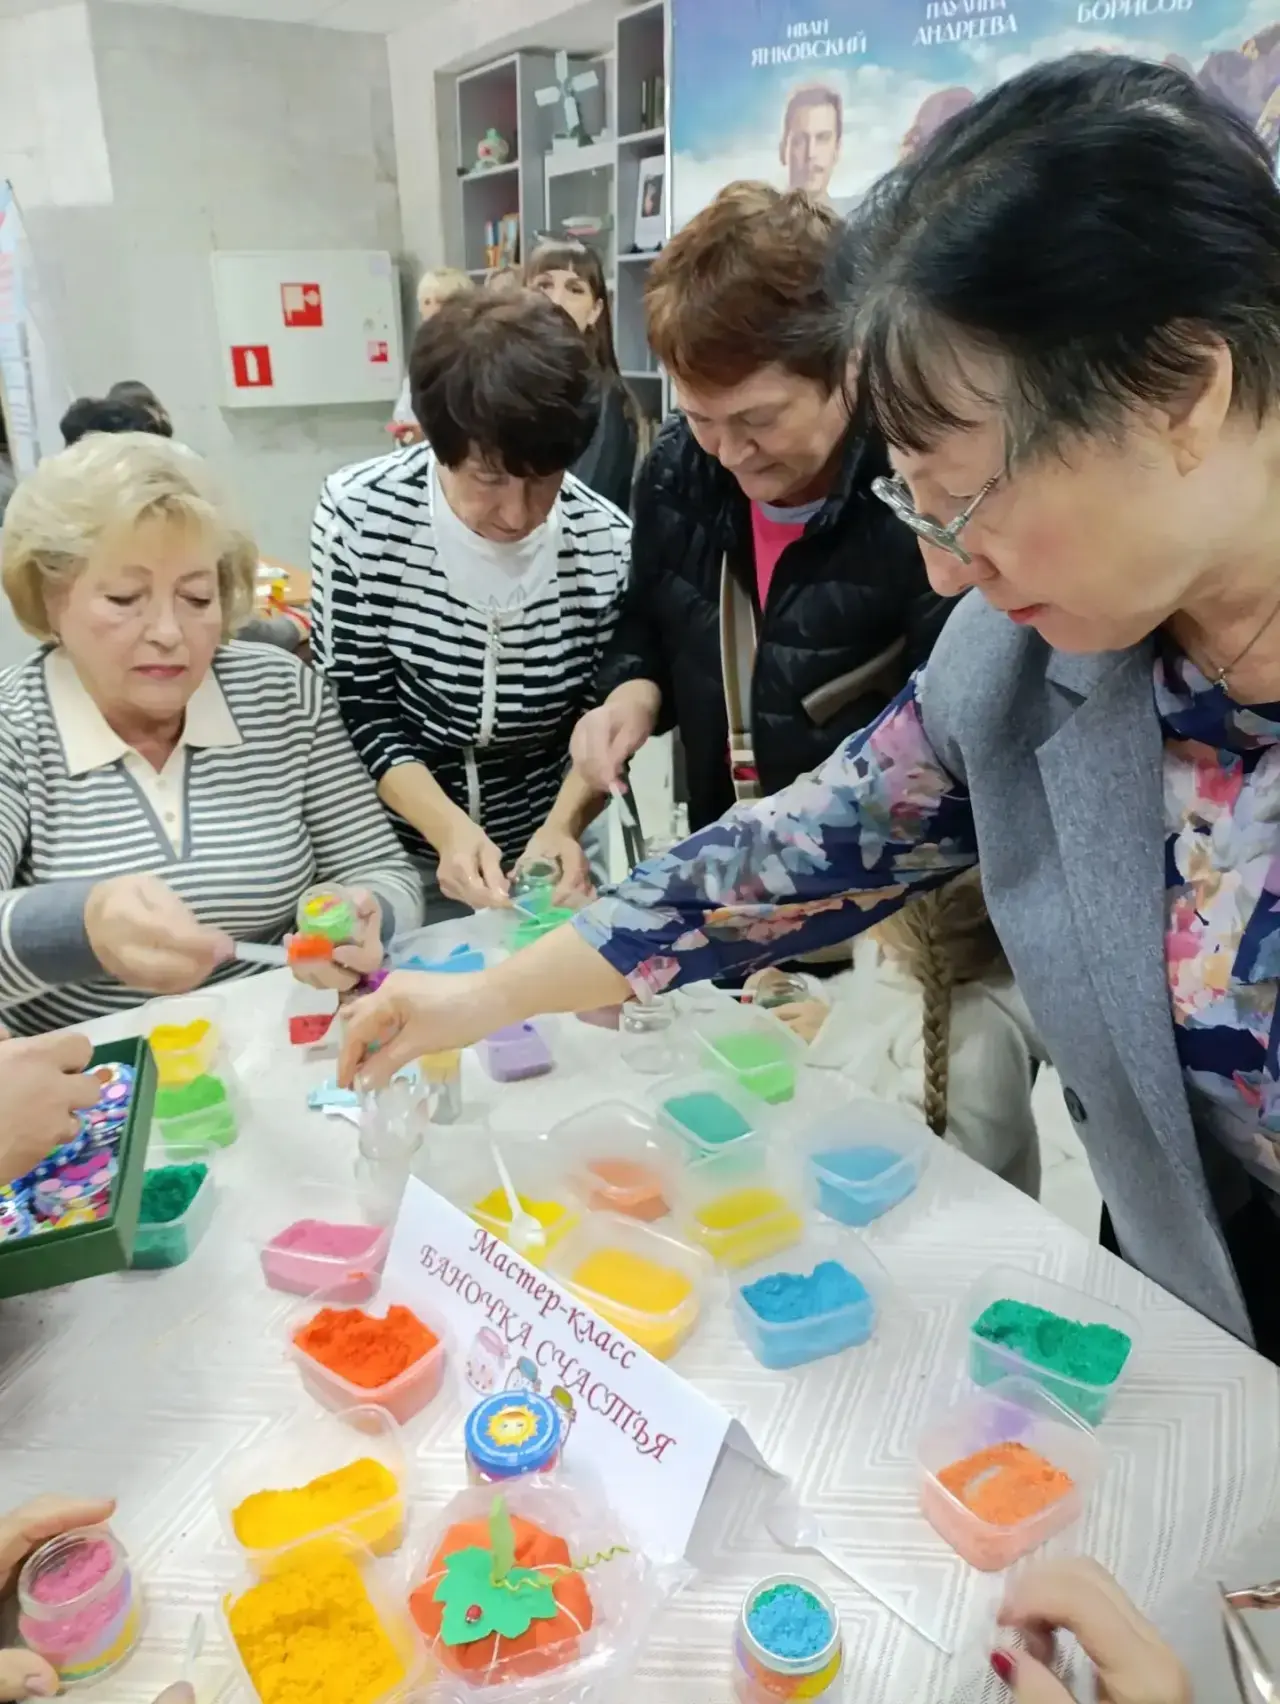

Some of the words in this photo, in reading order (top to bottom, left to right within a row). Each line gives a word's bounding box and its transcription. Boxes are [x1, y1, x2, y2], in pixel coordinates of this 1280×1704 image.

[786, 19, 829, 39] ИВАН
[912, 13, 1018, 46] АНДРЕЕВА
[751, 30, 867, 67] ЯНКОВСКИЙ
[468, 1228, 637, 1370] Мастер-класс
[419, 1244, 534, 1350] БАНОЧКА
[535, 1339, 677, 1463] СЧАСТЬЯ
